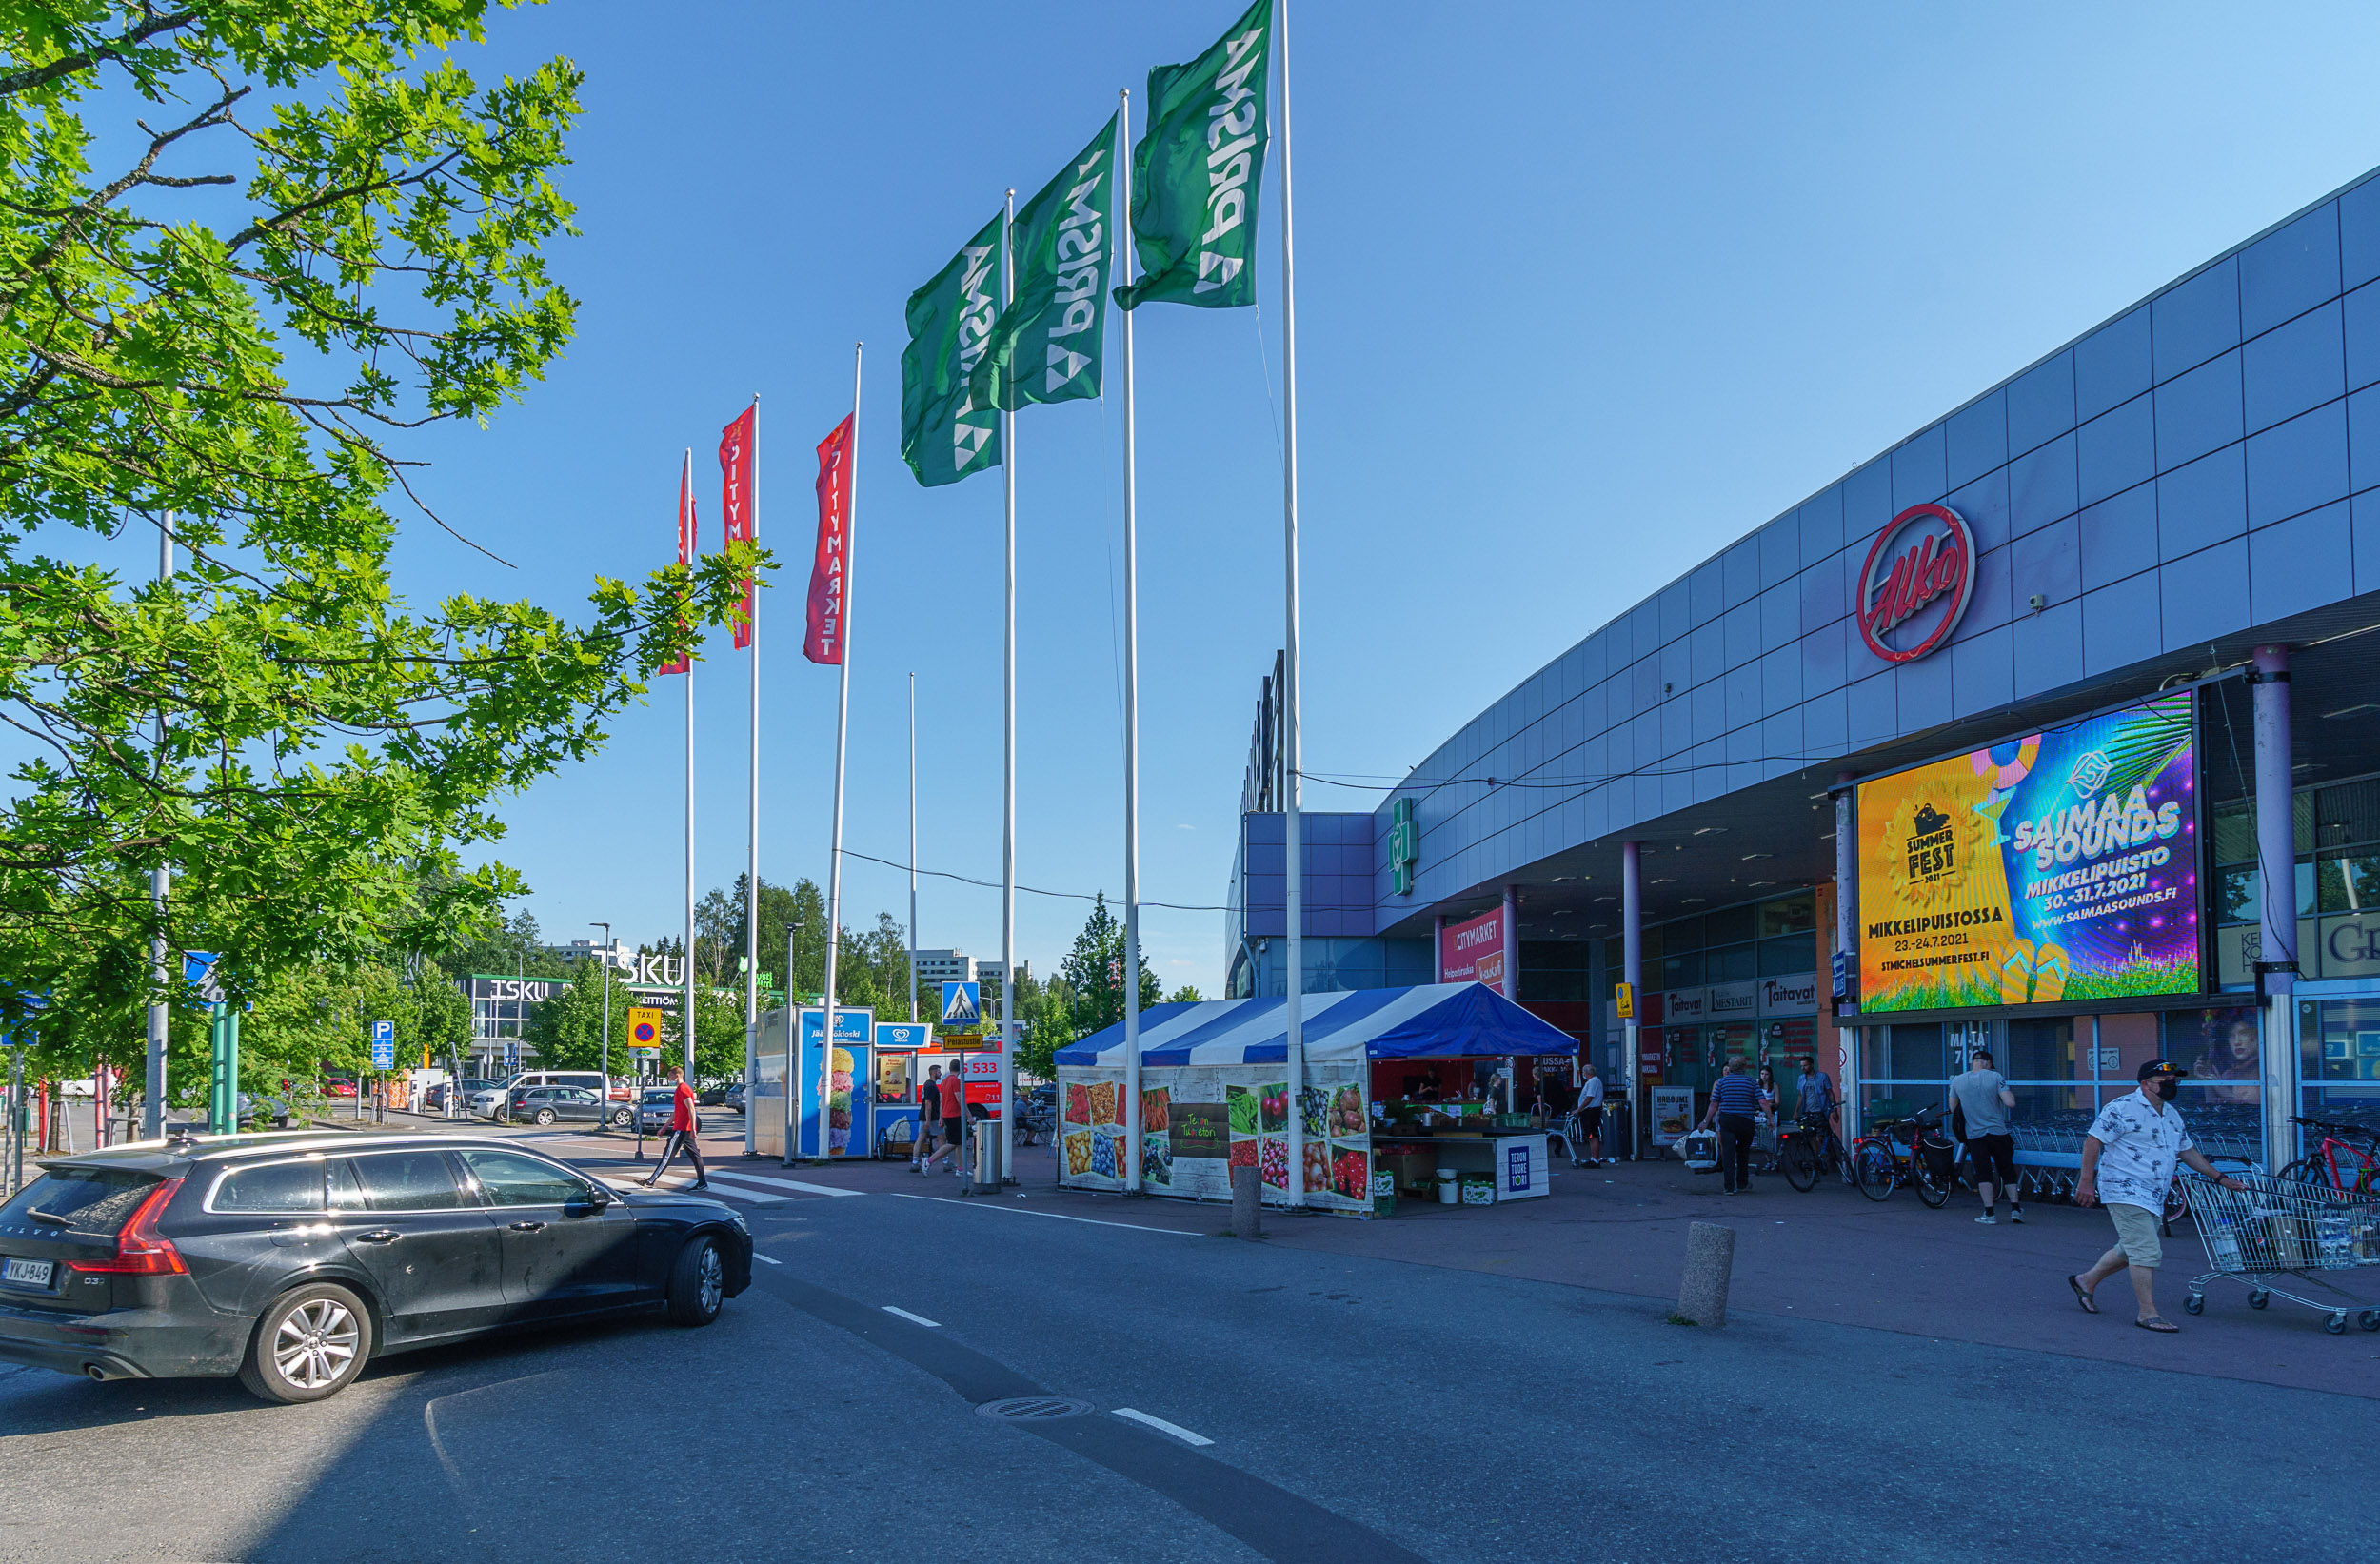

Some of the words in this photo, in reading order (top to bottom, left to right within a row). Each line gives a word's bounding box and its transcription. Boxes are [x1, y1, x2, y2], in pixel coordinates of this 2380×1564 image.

[1866, 534, 1957, 630] Alko
[2014, 784, 2149, 853] SAIMAA
[1907, 829, 1954, 854] SUMMER
[2035, 801, 2182, 872] SOUNDS
[1908, 843, 1954, 879] FEST
[1925, 873, 1941, 884] 2021
[2025, 846, 2171, 900] MIKKELIPUISTO
[2044, 872, 2147, 912] 30.-31.7.2021
[2032, 887, 2177, 930] WWW.SAIMAASOUNDS.FI
[1869, 906, 2003, 939] MIKKELIPUISTOSSA
[1456, 920, 1497, 951] CITYMARKET
[1894, 932, 1969, 952] 23.-24.7.2021
[1881, 951, 1990, 971] STMICHELSUMMERFEST.FI
[756, 972, 773, 980] usti
[490, 980, 549, 1000] ISKU
[1763, 979, 1815, 1008] Taitavat
[1715, 995, 1753, 1008] MESTARIT
[376, 1022, 390, 1039] P
[811, 1029, 861, 1039] Jääökioski
[947, 1038, 981, 1046] Pelastustie
[972, 1062, 997, 1074] 533
[1510, 1151, 1527, 1162] TERON
[1511, 1163, 1527, 1175] TUORE
[1512, 1175, 1528, 1187] TORI
[9, 1261, 49, 1281] YKJ-849
